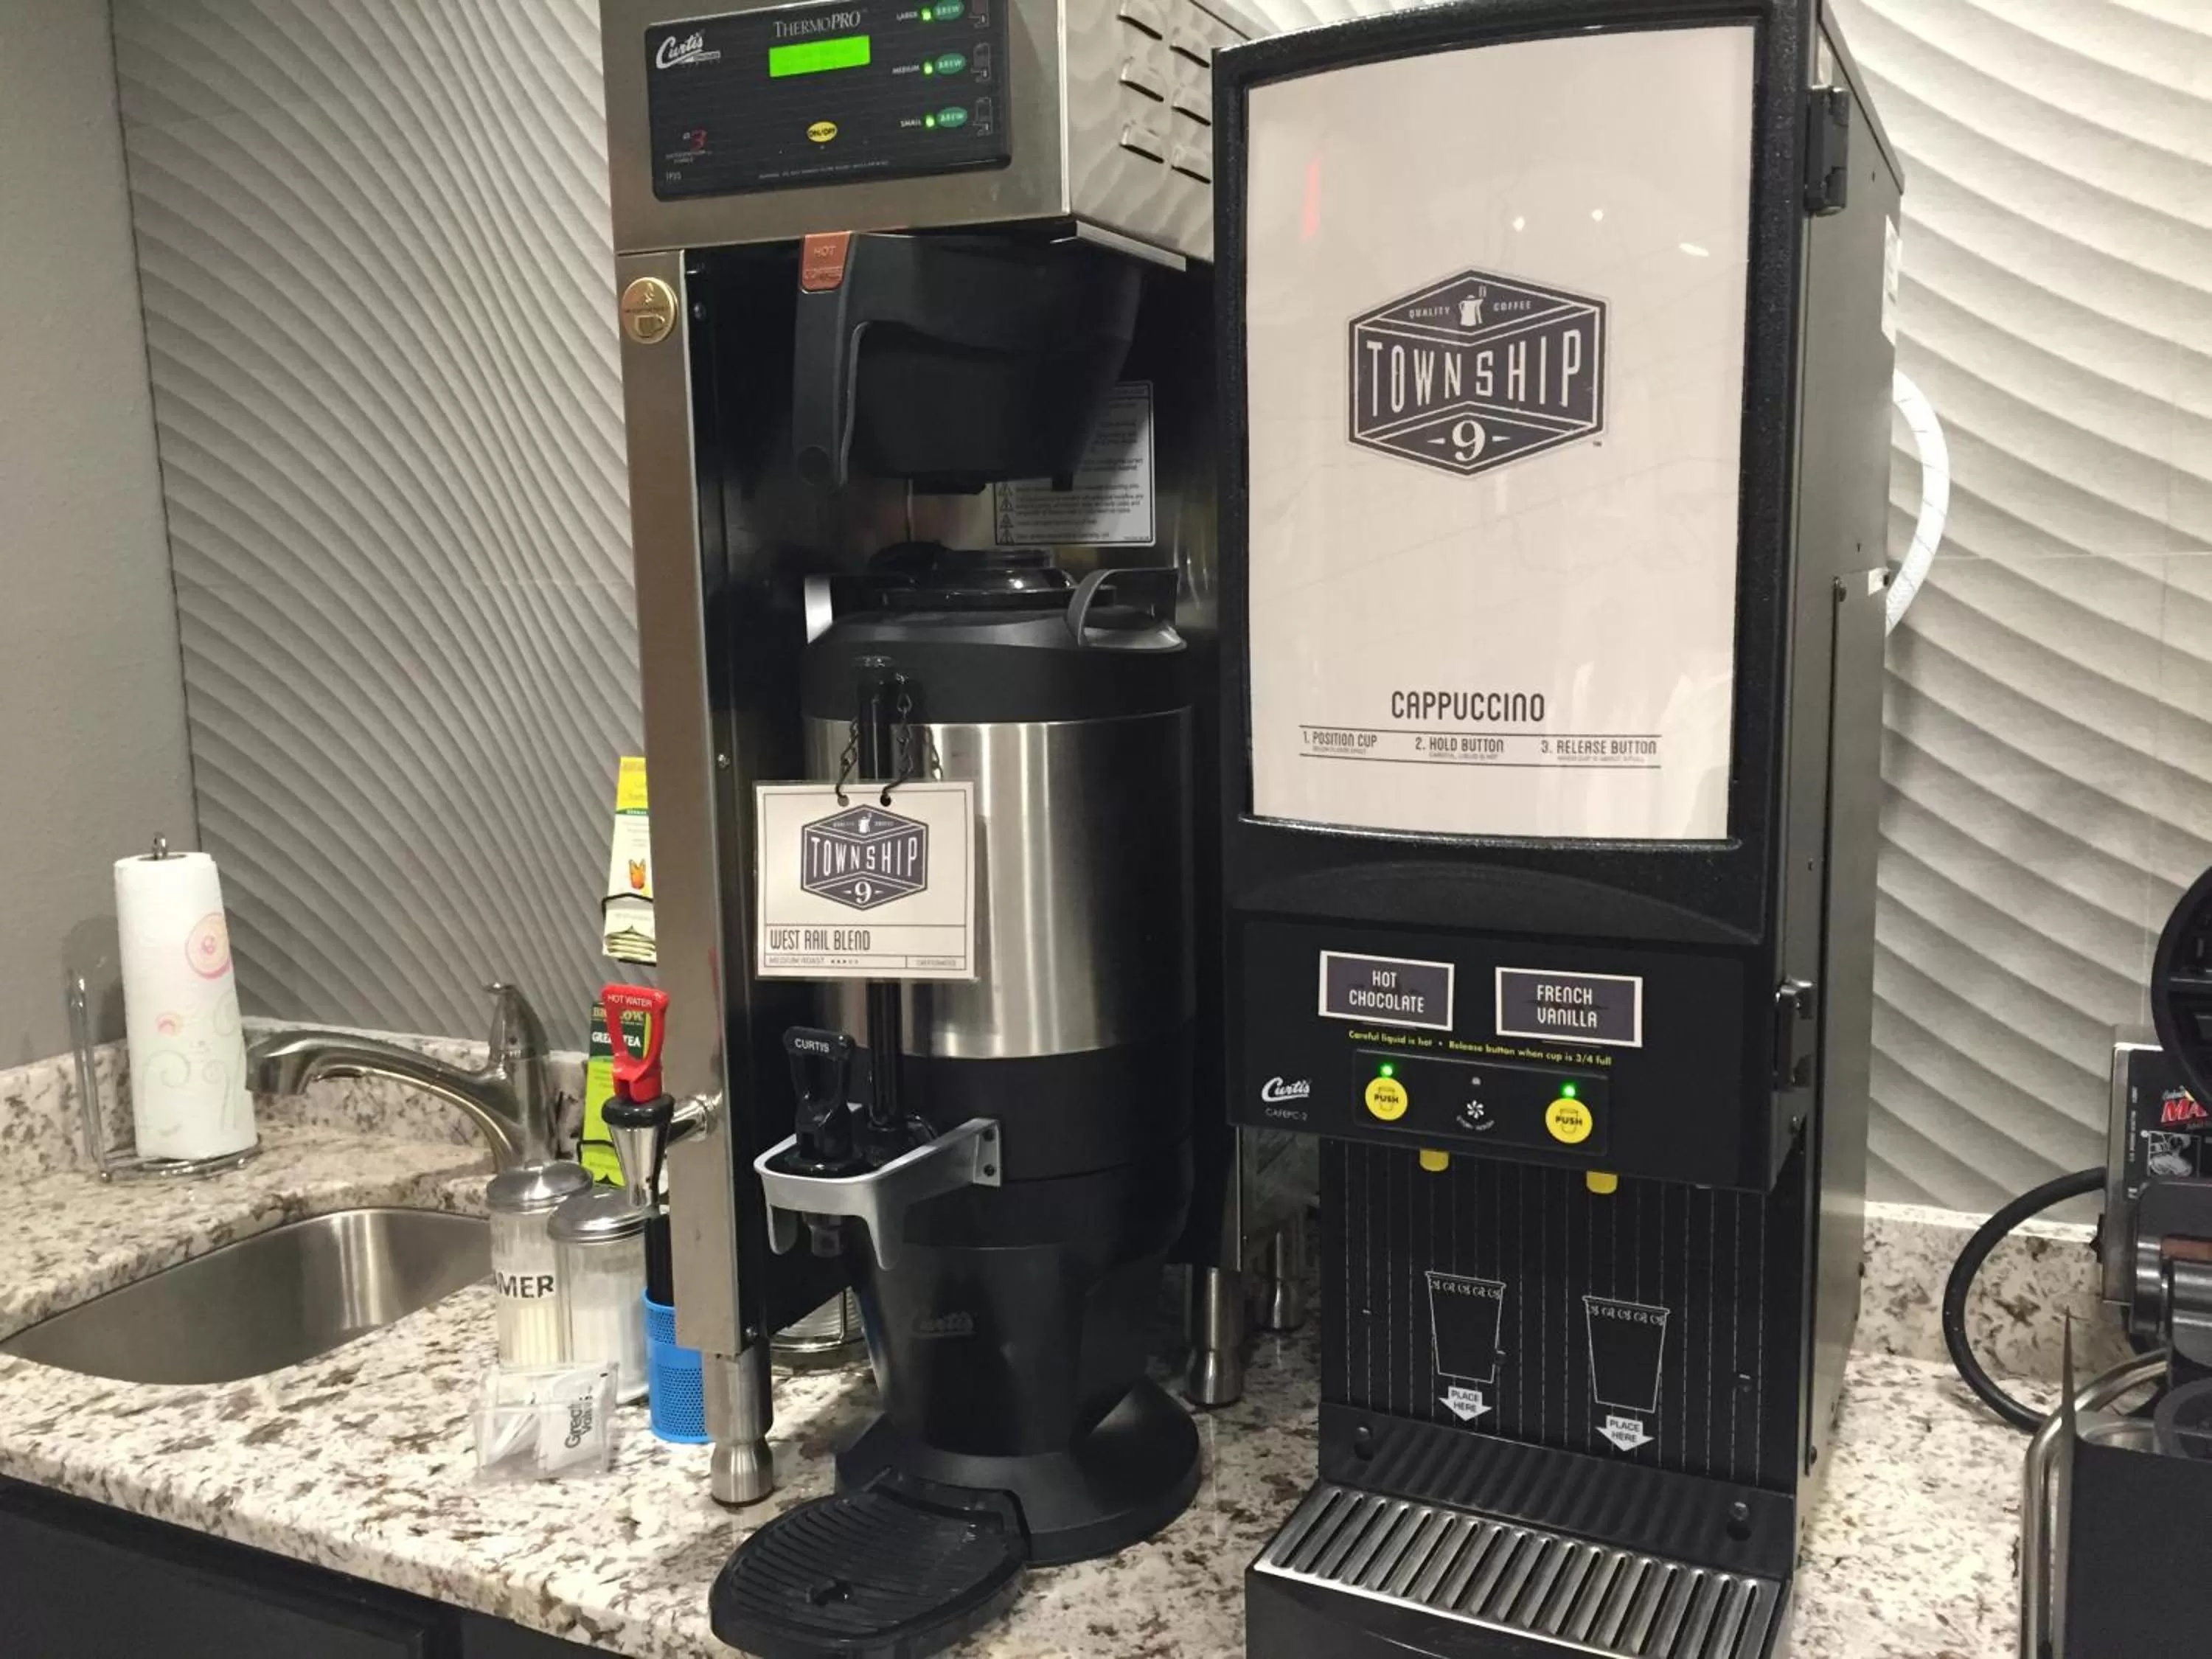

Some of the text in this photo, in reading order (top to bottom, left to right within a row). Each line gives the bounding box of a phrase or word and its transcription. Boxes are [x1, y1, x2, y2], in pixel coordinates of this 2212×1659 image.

[655, 32, 703, 69] Curtis
[938, 59, 963, 69] BREW
[1408, 299, 1532, 319] QUALITY COFFEE
[1366, 329, 1582, 417] TOWNSHIP
[1451, 420, 1486, 462] 9
[1391, 691, 1545, 723] CAPPUCCINO
[1312, 731, 1354, 747] POSITION
[1357, 734, 1378, 748] CUP
[1415, 737, 1503, 753] 2. HOLD BUTTON
[1541, 740, 1657, 755] 3. RELEASE BUTTON
[810, 837, 919, 877] TOWNSHIP
[855, 881, 873, 904] 9
[771, 930, 871, 951] WEST RAIL BLEND
[1371, 970, 1398, 990] HOT
[607, 994, 653, 1008] HOT WATER
[1349, 989, 1425, 1015] CHOCOLATE
[1537, 984, 1593, 1006] FRENCH
[1537, 1006, 1599, 1029] VANILLA
[794, 1037, 830, 1054] CURTIS
[1349, 1030, 1380, 1041] Careful
[1381, 1032, 1406, 1045] liquid
[1418, 1036, 1433, 1046] hot
[1449, 1040, 1484, 1053] Release
[1486, 1044, 1515, 1056] button
[1517, 1048, 1543, 1059] when
[1545, 1051, 1562, 1062] cup
[1565, 1052, 1573, 1062] is
[1596, 1055, 1613, 1066] full
[1262, 1076, 1310, 1102] Curtis
[1374, 1093, 1399, 1105] PUSH
[1555, 1115, 1583, 1127] PUSH
[1450, 1389, 1481, 1402] PLACE
[1453, 1401, 1477, 1413] HERE
[1609, 1419, 1641, 1431] PLACE
[1610, 1430, 1637, 1443] HERE
